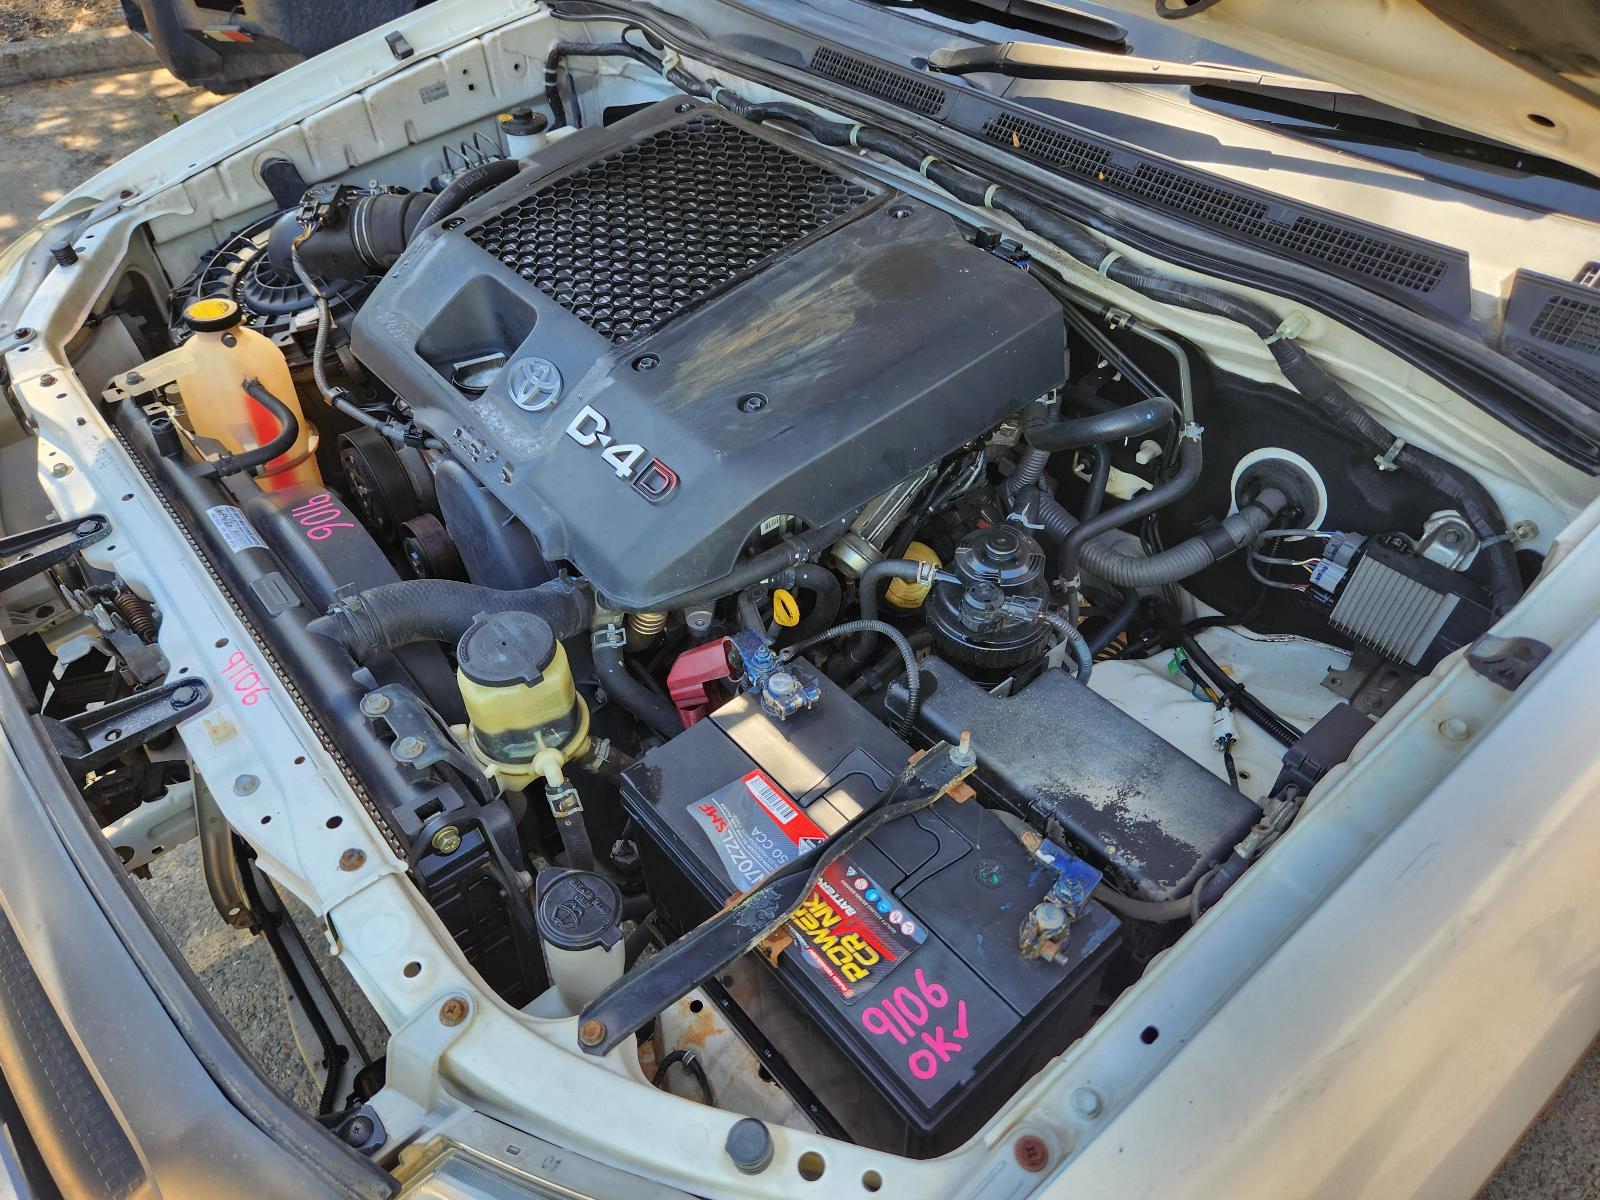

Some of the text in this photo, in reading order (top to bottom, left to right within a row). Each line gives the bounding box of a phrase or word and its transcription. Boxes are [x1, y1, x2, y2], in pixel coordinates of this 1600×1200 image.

[566, 405, 679, 503] D-4D
[291, 494, 354, 540] 9106
[221, 651, 271, 706] 9106
[698, 803, 728, 833] SMF
[751, 826, 774, 849] CCA
[861, 968, 949, 1045] 9106
[908, 1026, 962, 1080] OK
